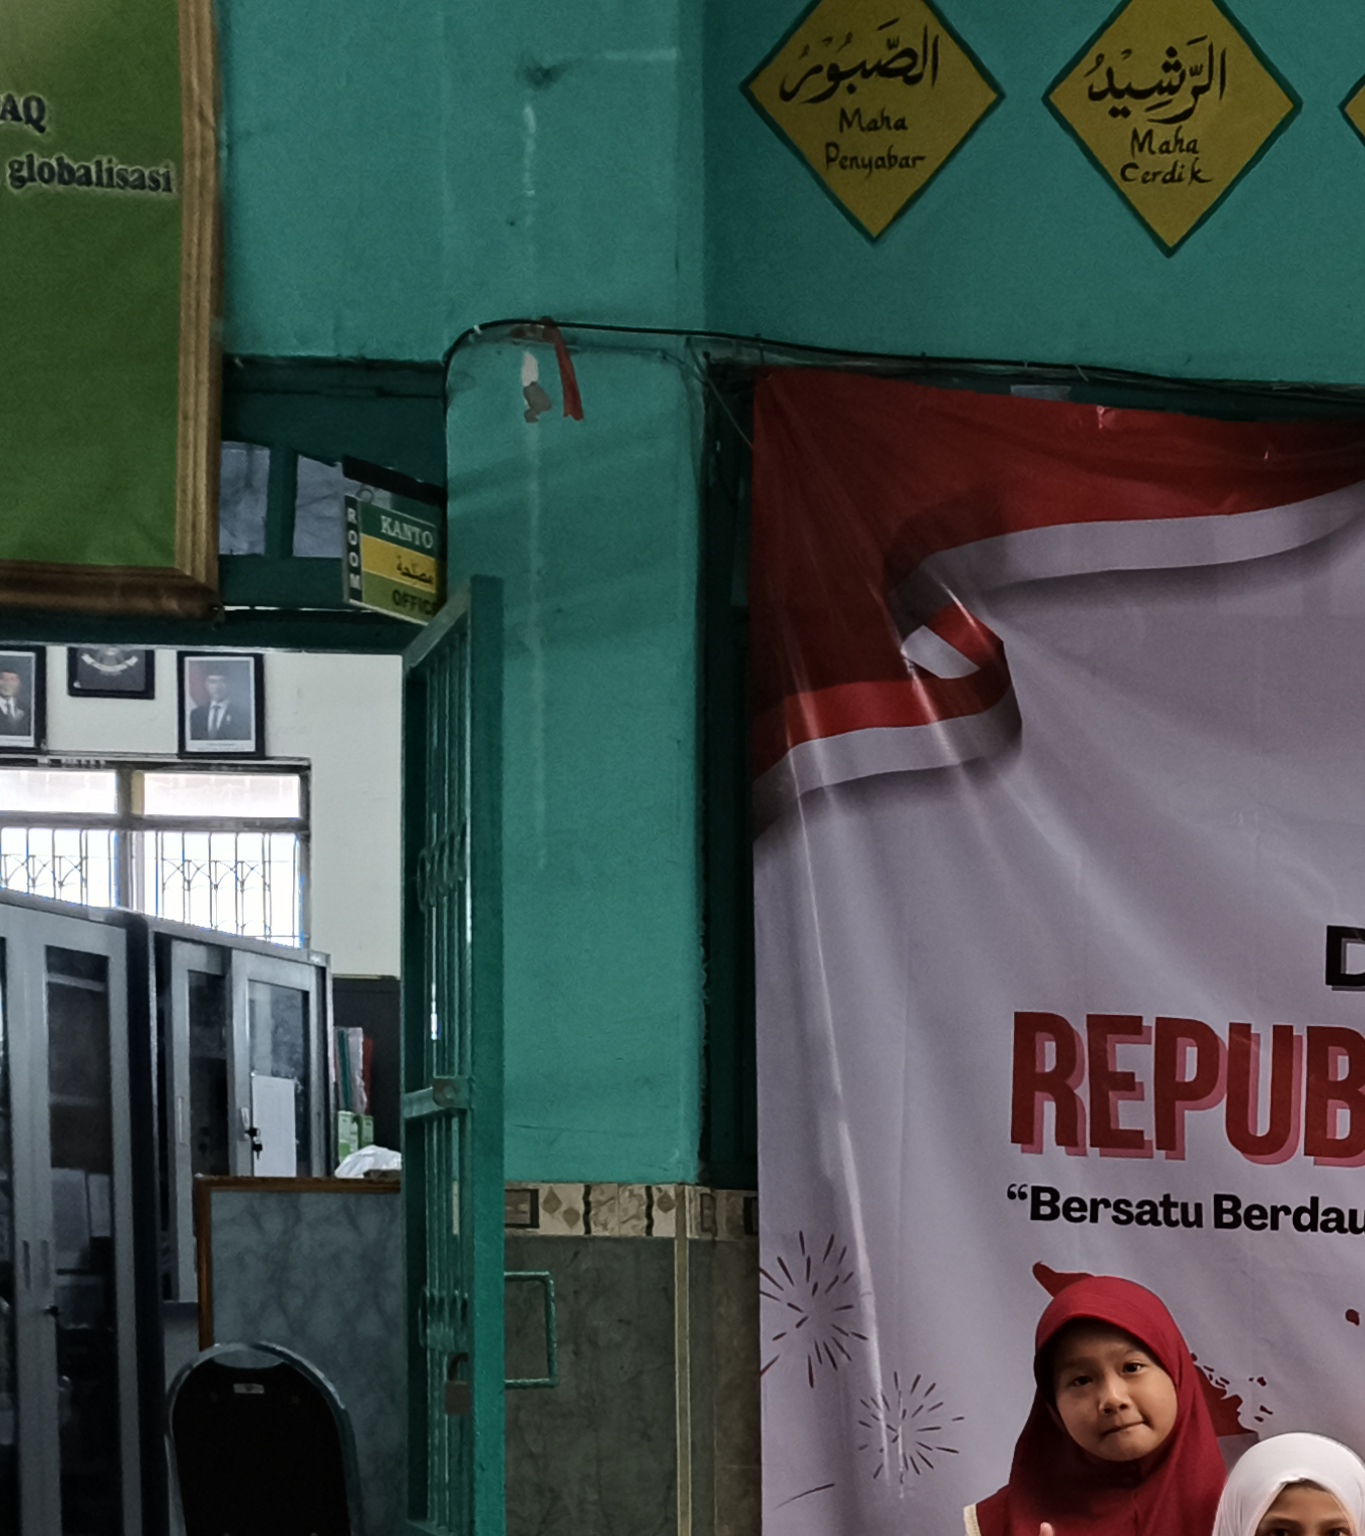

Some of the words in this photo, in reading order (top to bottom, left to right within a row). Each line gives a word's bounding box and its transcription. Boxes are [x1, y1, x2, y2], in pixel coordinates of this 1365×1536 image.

[839, 107, 909, 133] Maha
[1130, 126, 1199, 158] Maha
[8, 154, 173, 193] globalisasi
[825, 142, 926, 181] Penyabar
[1120, 157, 1213, 185] Cerdik
[380, 515, 434, 548] KANTO
[347, 507, 360, 590] ROOM
[392, 589, 437, 616] OFFIC
